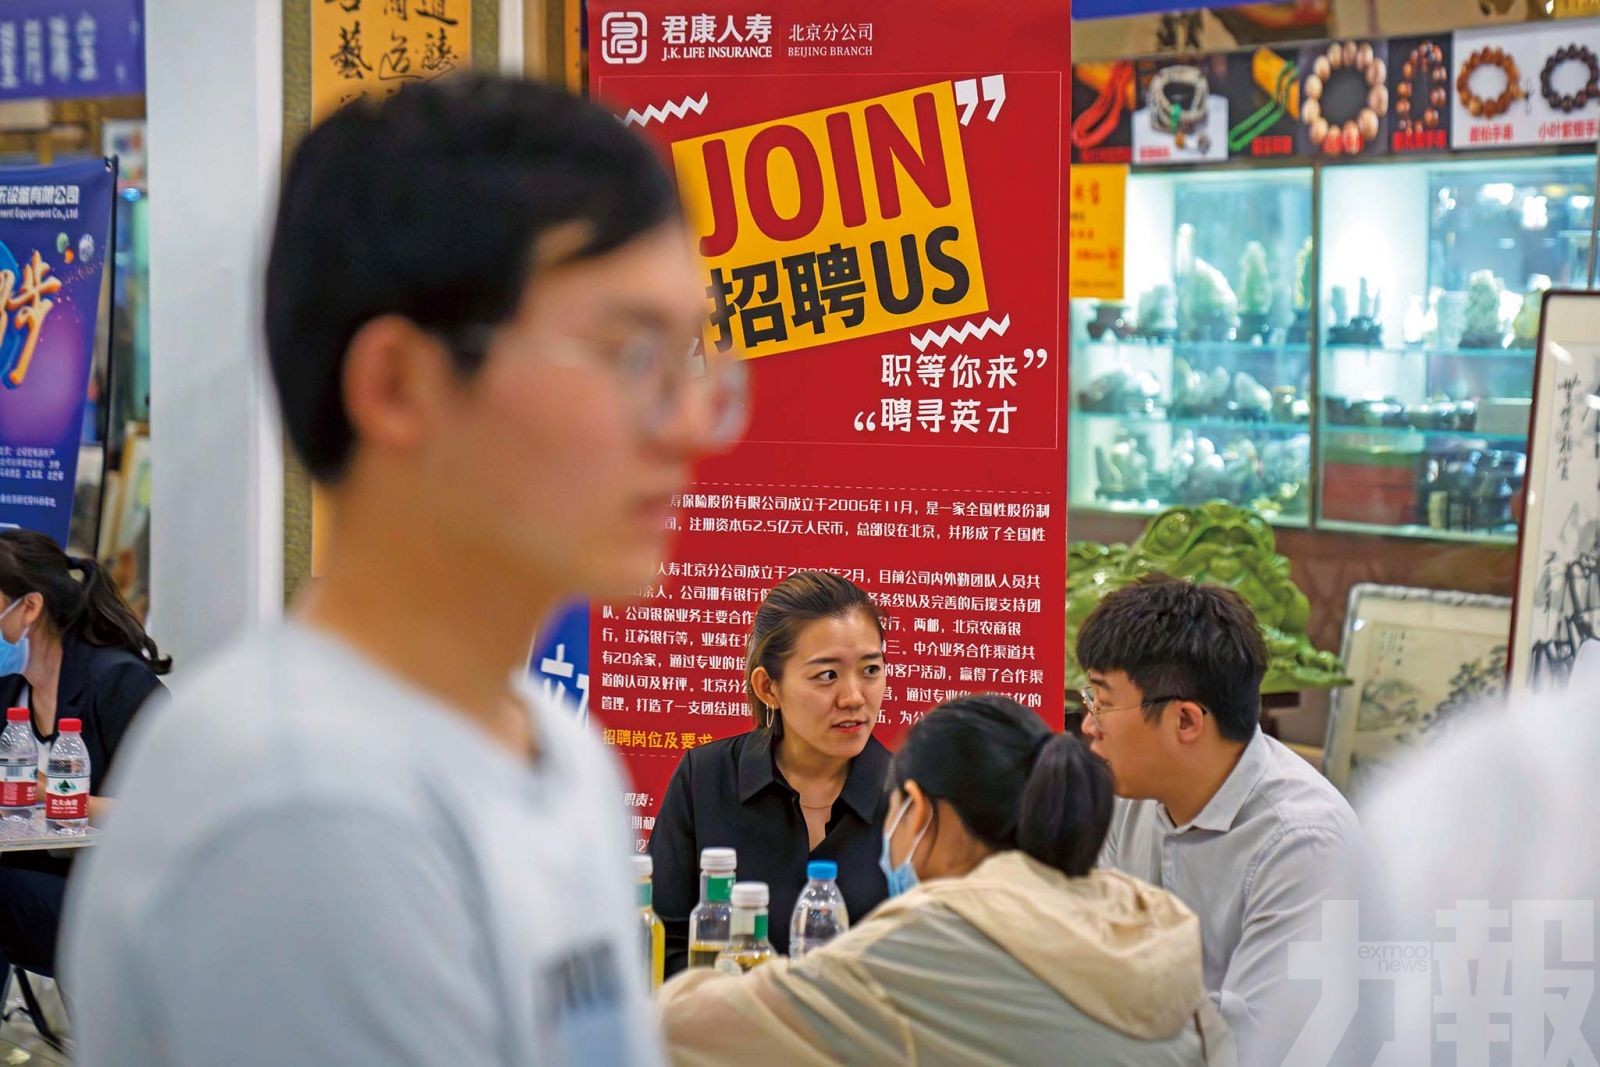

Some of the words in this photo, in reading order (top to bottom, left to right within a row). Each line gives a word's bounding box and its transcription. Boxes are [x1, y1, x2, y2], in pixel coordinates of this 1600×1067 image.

[661, 13, 772, 44] 君康人寿
[788, 23, 873, 42] 北京分公司
[662, 47, 681, 61] J.K.
[683, 47, 705, 58] LIFE
[708, 46, 772, 58] INSURANCE
[788, 46, 827, 57] BEIJING
[830, 46, 873, 56] BRANCH
[699, 92, 952, 257] JOIN
[705, 243, 867, 353] 招聘
[870, 226, 970, 315] US
